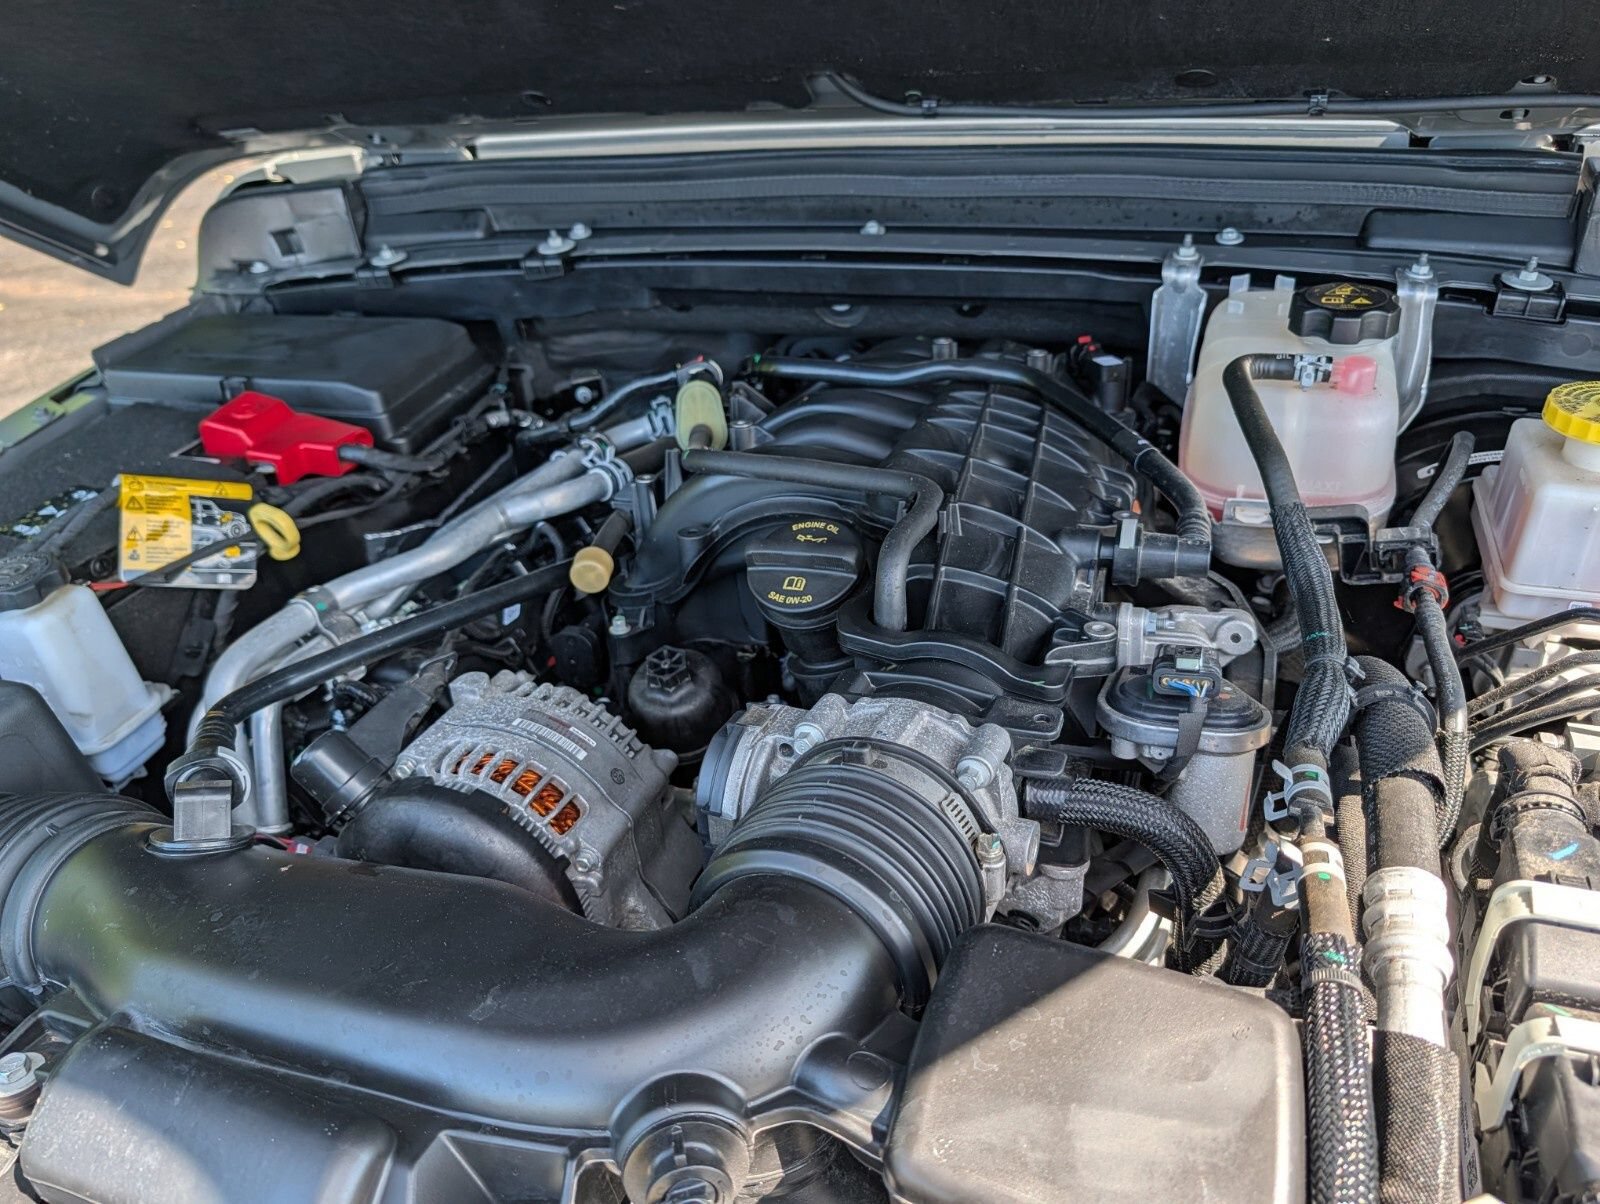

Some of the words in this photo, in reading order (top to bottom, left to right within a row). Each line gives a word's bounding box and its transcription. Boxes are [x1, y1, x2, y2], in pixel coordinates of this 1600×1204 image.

[792, 521, 826, 531] ENGINE
[826, 524, 840, 535] OIL
[768, 591, 785, 603] SAE
[785, 594, 812, 605] 0W-20
